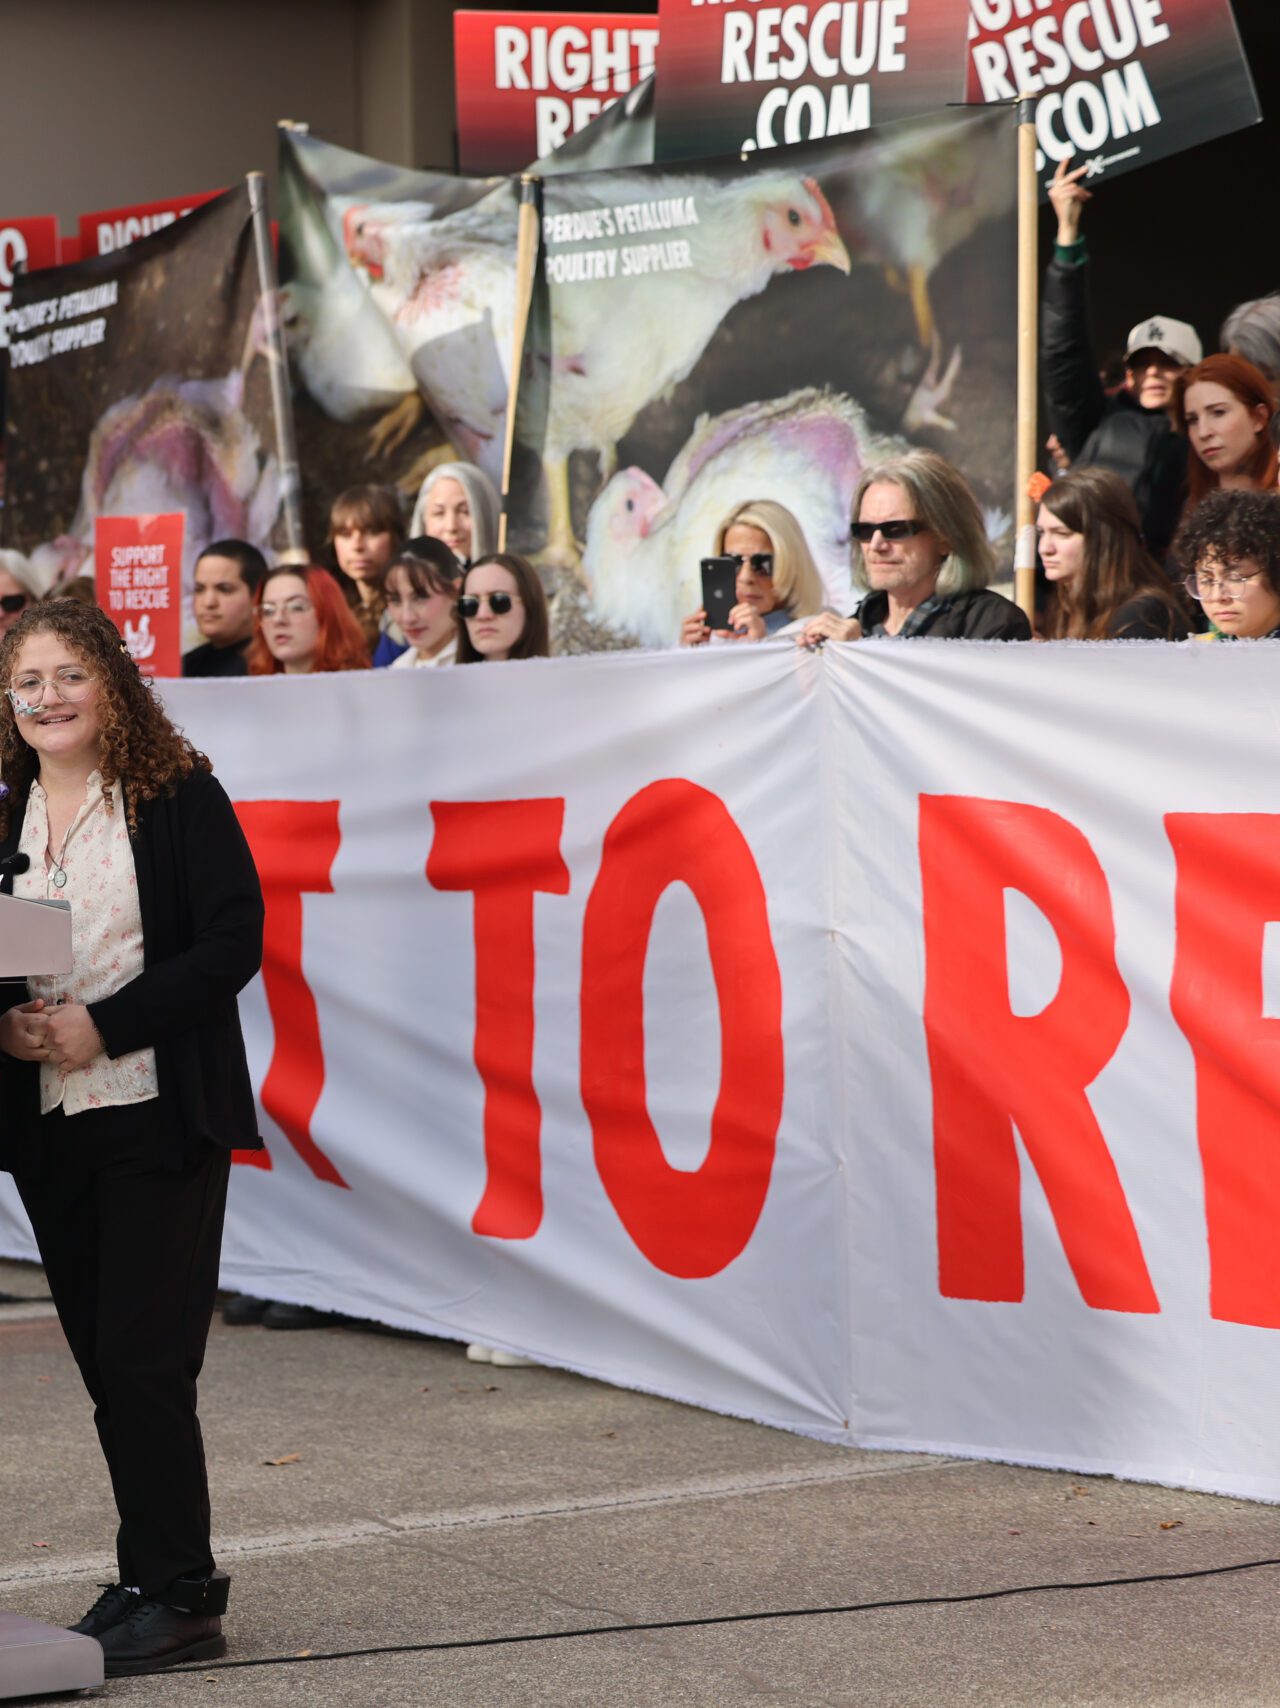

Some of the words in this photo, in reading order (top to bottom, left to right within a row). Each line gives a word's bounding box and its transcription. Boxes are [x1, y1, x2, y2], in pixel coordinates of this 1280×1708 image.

[495, 25, 659, 93] RIGHT
[721, 0, 908, 83] RESCUE
[972, 0, 1170, 102] RESCUE
[544, 208, 616, 243] PERDUE'S
[614, 197, 700, 235] PETALUMA
[546, 248, 618, 285] POULTRY
[621, 239, 694, 276] SUPPLIER
[109, 567, 131, 588] THE
[133, 565, 169, 588] RIGHT
[111, 544, 166, 567] SUPPORT
[108, 589, 124, 611] TO
[125, 587, 170, 609] RESCUE
[425, 778, 784, 1280] TO
